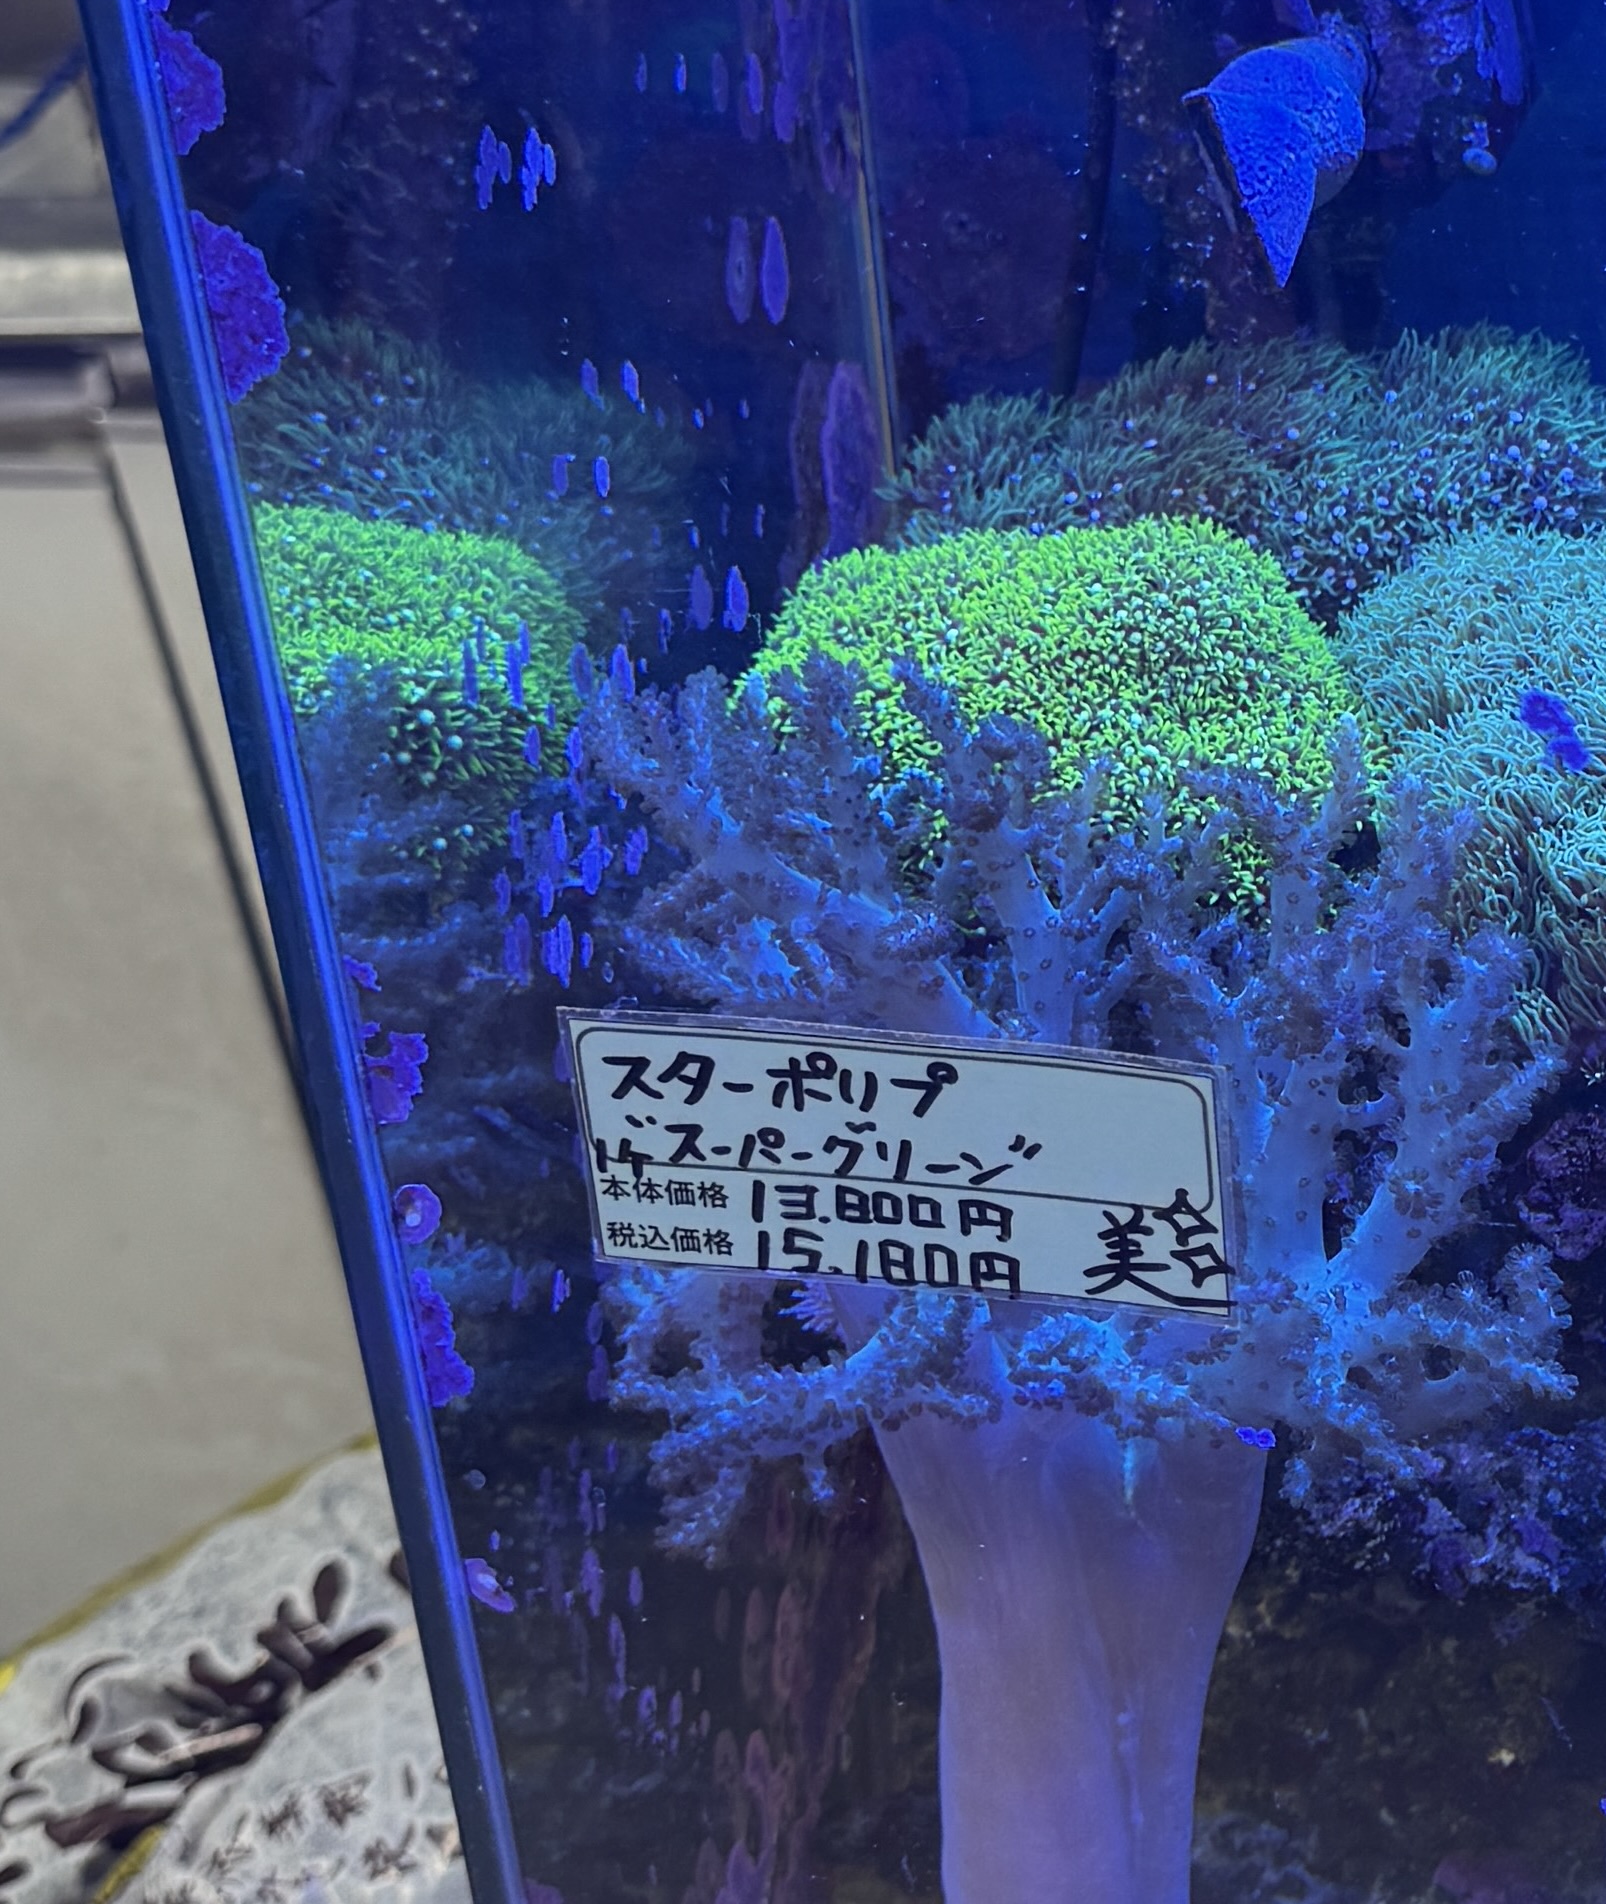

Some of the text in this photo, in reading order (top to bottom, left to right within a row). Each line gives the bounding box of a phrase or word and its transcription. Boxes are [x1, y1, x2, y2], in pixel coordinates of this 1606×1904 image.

[602, 1051, 959, 1118] スターポリプ
[601, 1174, 729, 1209] 本体価格
[607, 1222, 734, 1256] 税込価格
